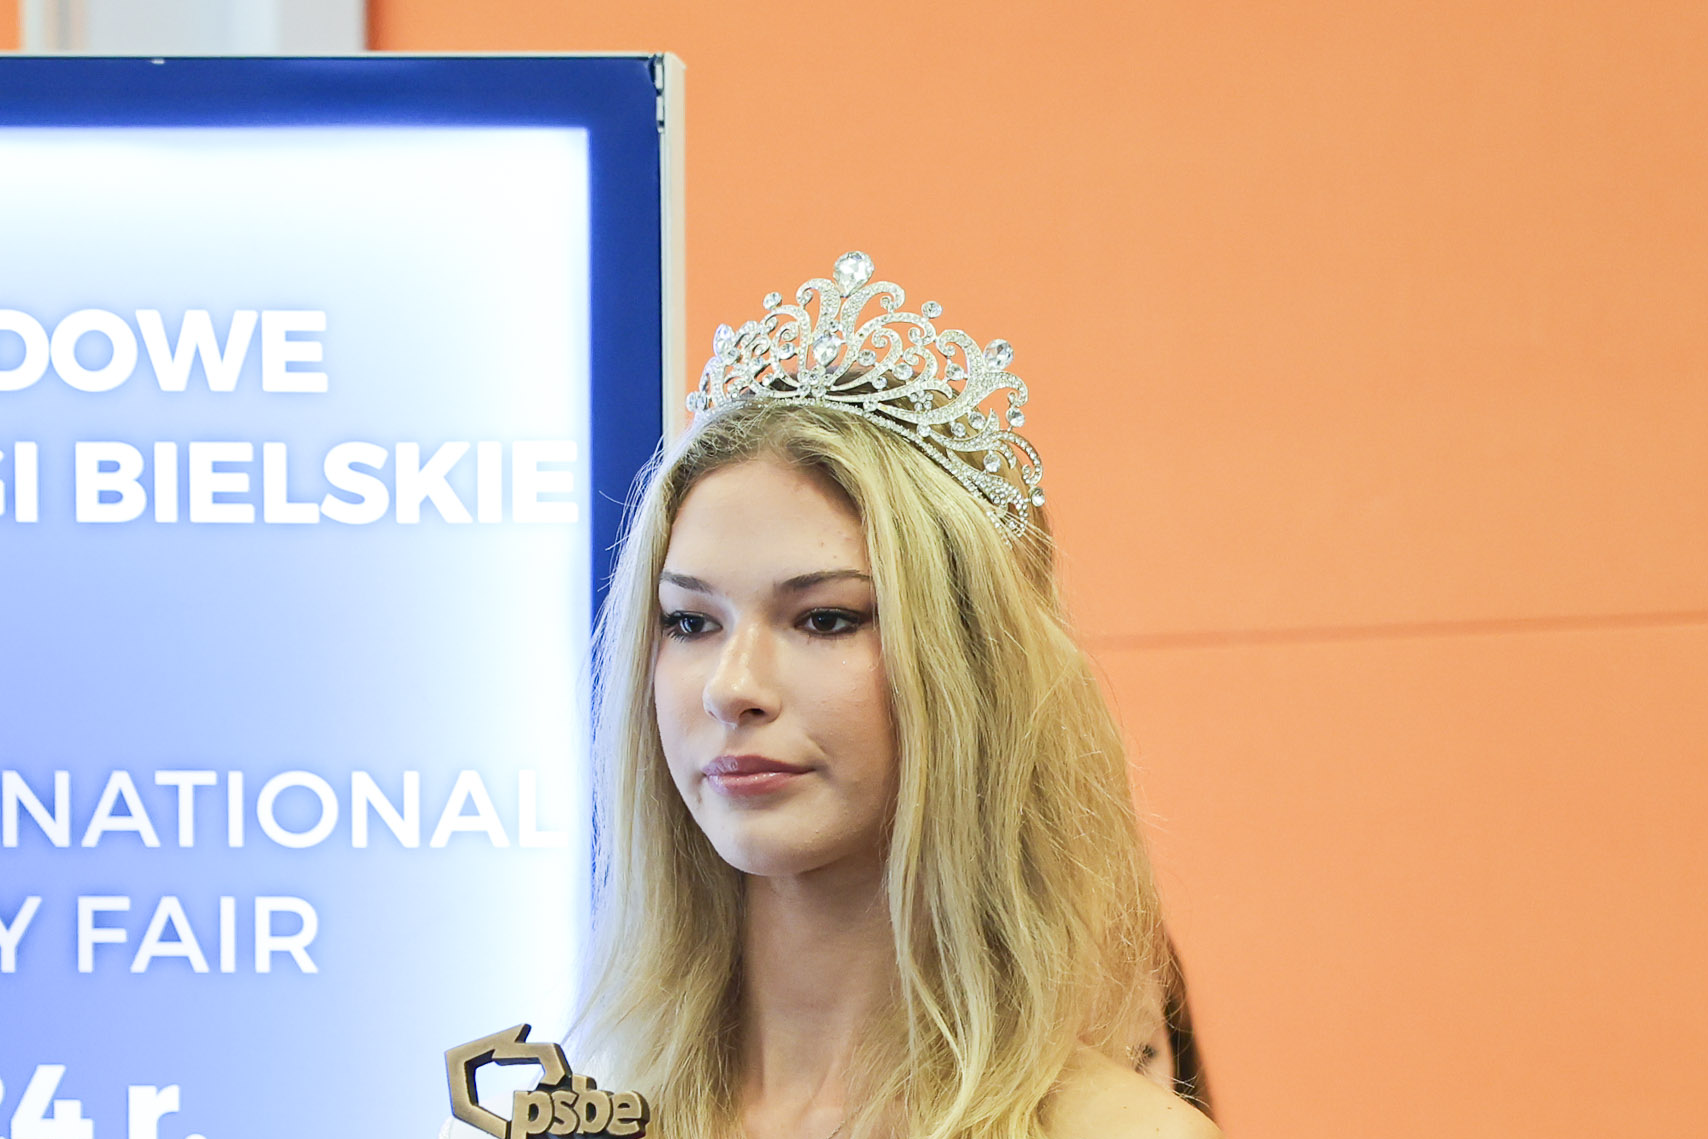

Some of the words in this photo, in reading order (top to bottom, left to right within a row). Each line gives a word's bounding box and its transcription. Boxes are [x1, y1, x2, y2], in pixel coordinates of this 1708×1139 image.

[75, 441, 579, 524] BIELSKIE
[1, 770, 571, 848] NATIONAL
[77, 896, 318, 973] FAIR
